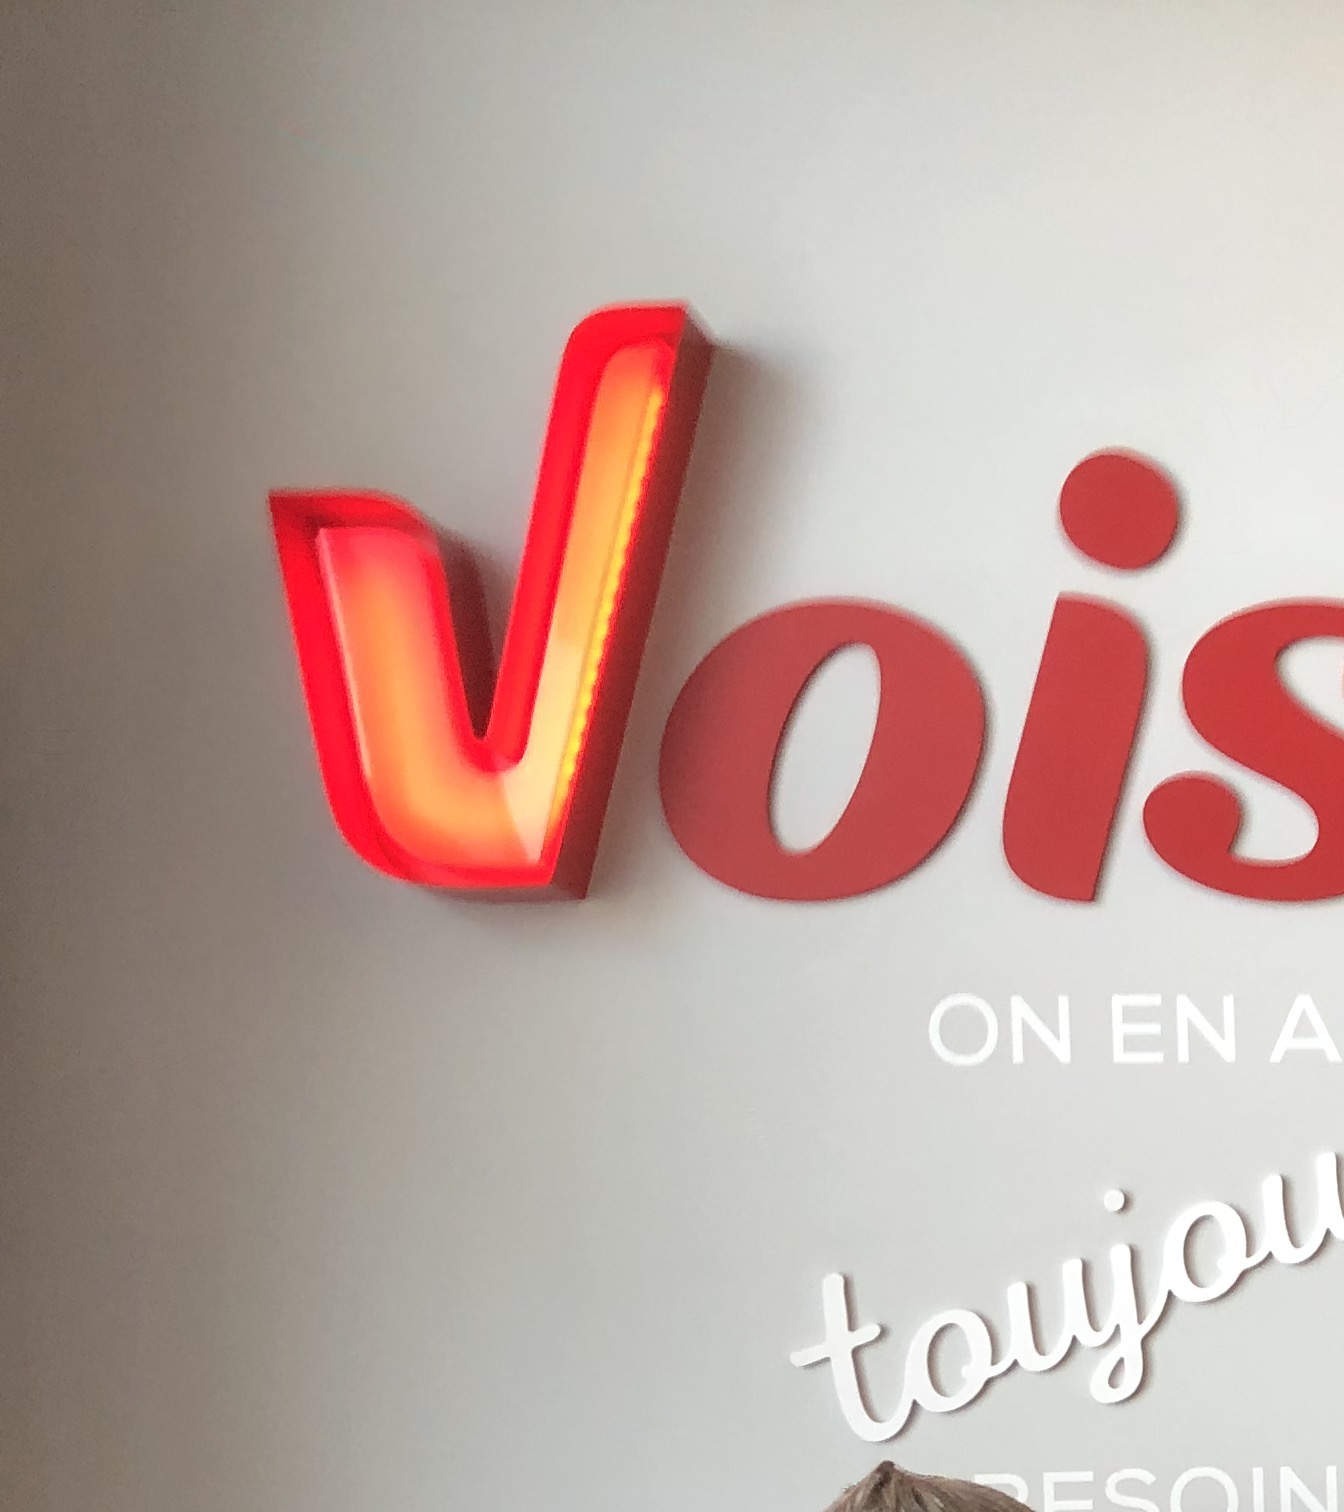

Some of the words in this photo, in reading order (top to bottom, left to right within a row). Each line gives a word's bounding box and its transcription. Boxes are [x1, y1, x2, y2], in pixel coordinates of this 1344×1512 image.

[927, 992, 1072, 1066] ON
[1111, 993, 1236, 1064] EN
[1269, 993, 1343, 1064] A
